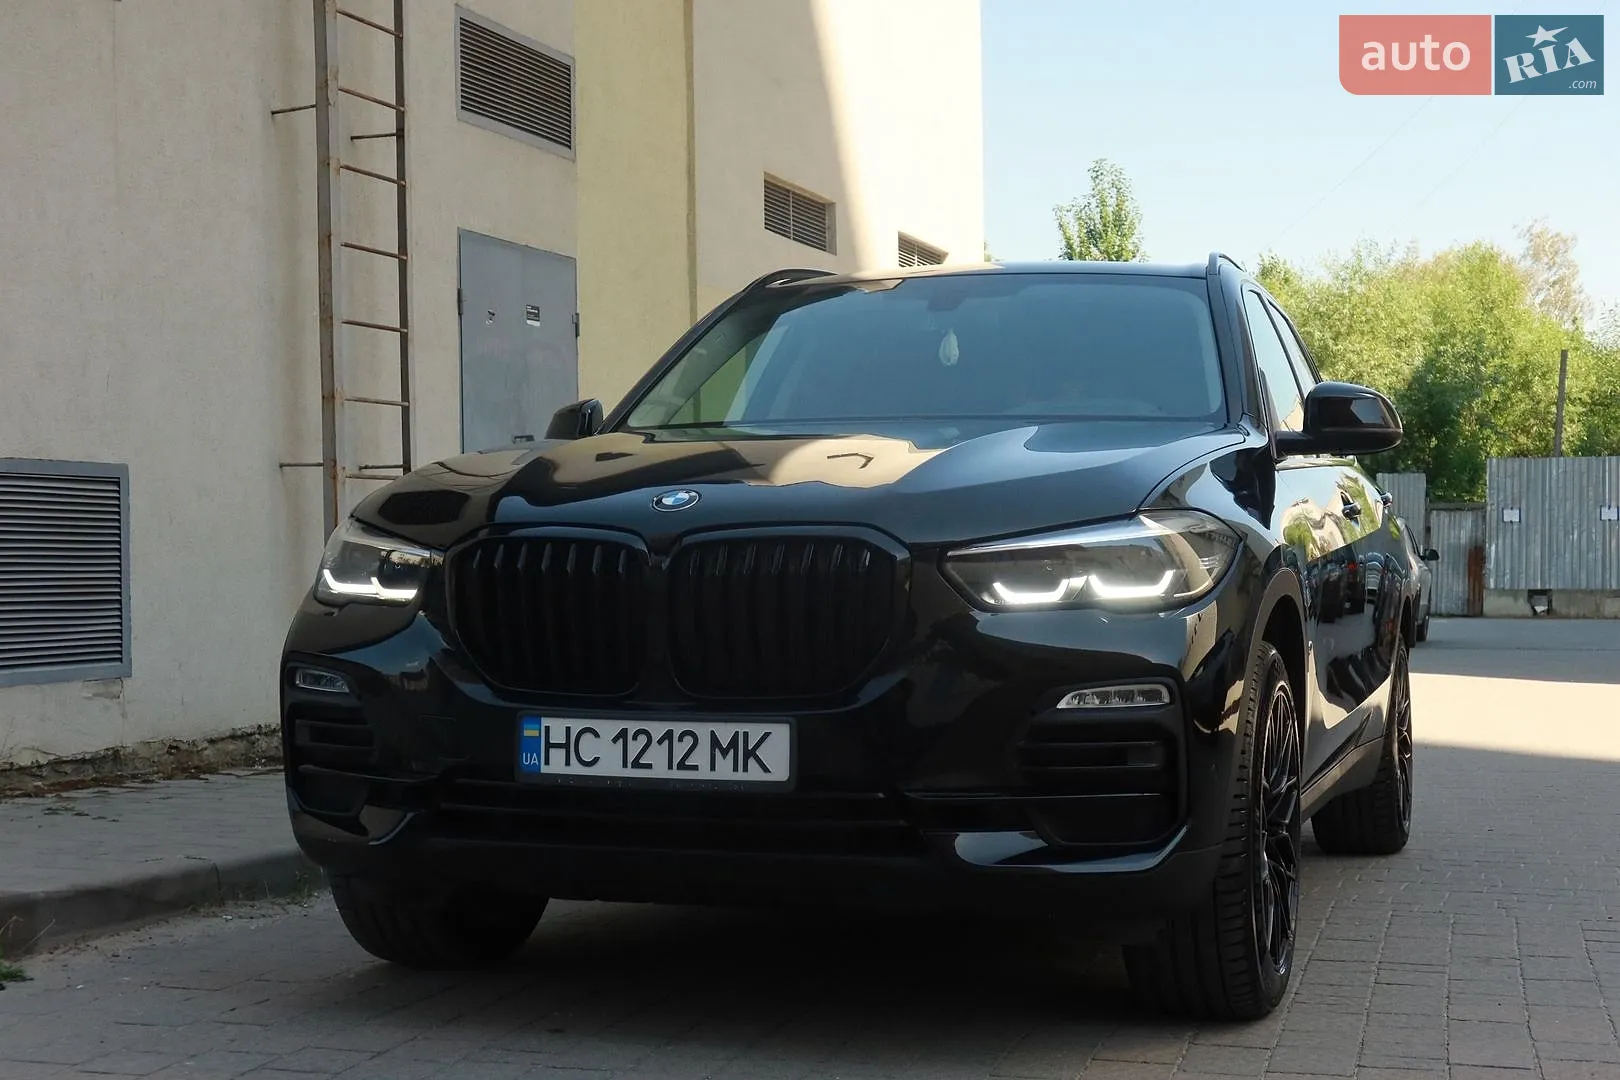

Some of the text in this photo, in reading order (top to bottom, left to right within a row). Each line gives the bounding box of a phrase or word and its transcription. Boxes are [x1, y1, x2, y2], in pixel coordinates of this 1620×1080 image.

[523, 752, 539, 766] UA
[544, 725, 772, 773] HC 1212 MK
